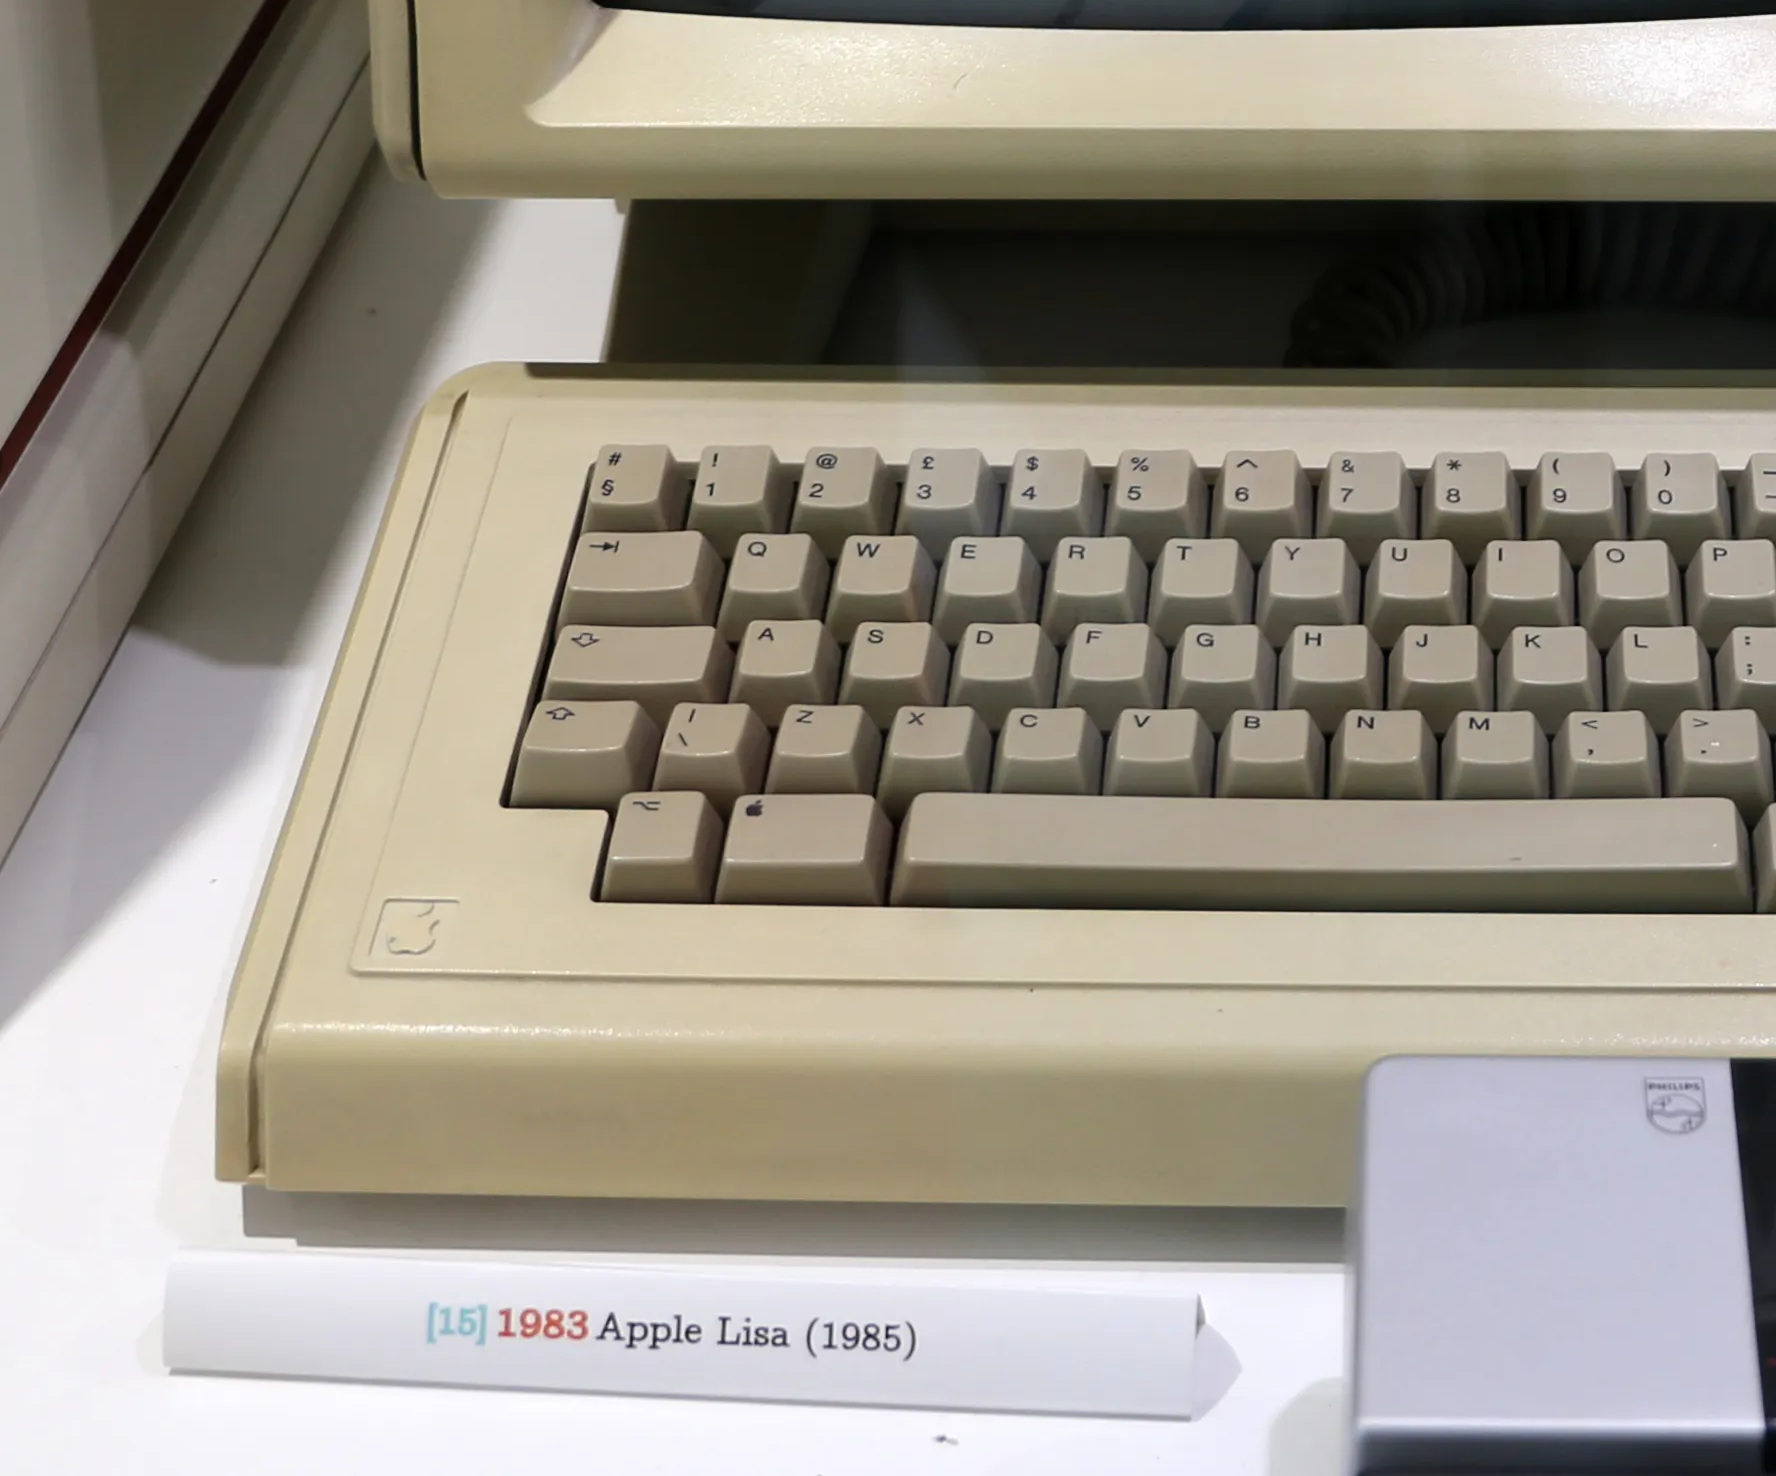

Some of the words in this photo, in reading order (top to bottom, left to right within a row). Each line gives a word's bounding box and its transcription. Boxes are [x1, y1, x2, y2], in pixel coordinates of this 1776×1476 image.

[807, 482, 825, 499] 2
[915, 483, 933, 501] 3
[1020, 485, 1038, 502] 4
[1126, 484, 1143, 502] 5
[1233, 485, 1250, 503] 6
[1339, 486, 1355, 504] 7
[1444, 486, 1462, 505] 8
[1551, 487, 1568, 505] 9
[1656, 488, 1674, 506] 0
[746, 540, 769, 558] Q
[855, 541, 882, 559] W
[959, 542, 978, 561] E
[1067, 543, 1087, 561] R
[1175, 544, 1193, 562] T
[1283, 545, 1301, 562] Y
[1390, 545, 1409, 563] U
[1604, 547, 1627, 565] O
[1711, 546, 1729, 563] P
[756, 626, 775, 643] A
[866, 628, 885, 645] S
[974, 629, 995, 646] D
[1084, 629, 1103, 645] F
[1195, 631, 1216, 649] G
[1303, 630, 1323, 648] H
[1414, 632, 1429, 649] J
[1523, 633, 1542, 650] K
[1632, 632, 1649, 650] L
[794, 708, 815, 725] Z
[906, 710, 926, 727] X
[1018, 713, 1039, 729] C
[1132, 713, 1152, 729] V
[1242, 714, 1262, 730] B
[1356, 714, 1376, 731] N
[1467, 715, 1491, 732] M
[1648, 1082, 1701, 1091] PHILIPS
[426, 1302, 488, 1346] [15]
[497, 1308, 589, 1340] 1983
[596, 1311, 703, 1350] Apple
[716, 1317, 791, 1348] Lisa
[804, 1317, 919, 1361] (1985)
